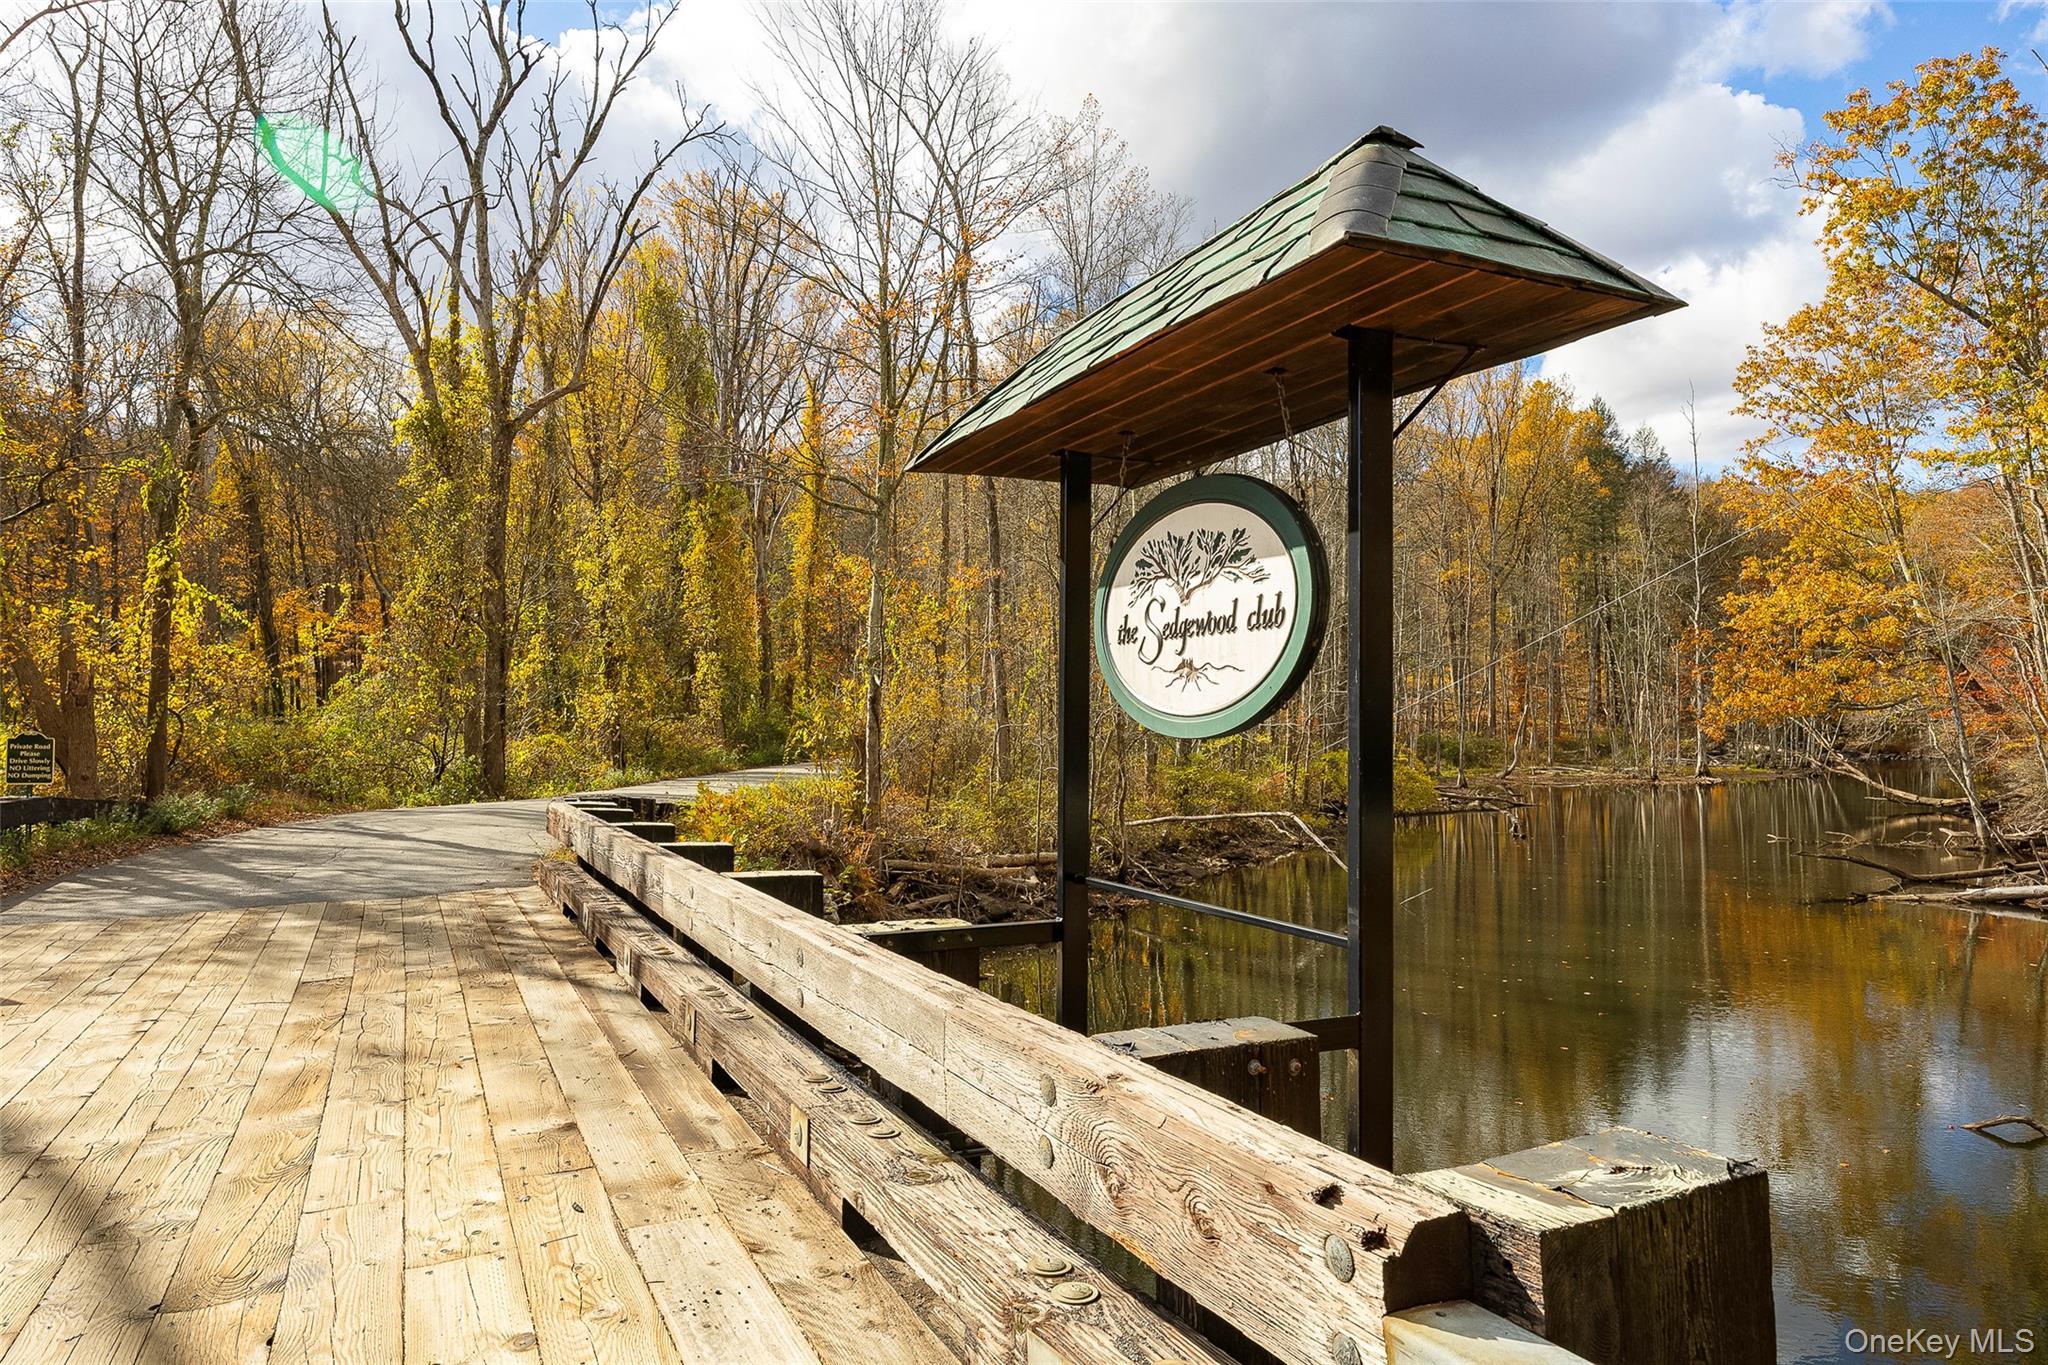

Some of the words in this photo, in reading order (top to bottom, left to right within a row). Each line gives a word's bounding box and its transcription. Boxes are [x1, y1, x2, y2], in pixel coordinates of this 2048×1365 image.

[1117, 614, 1139, 646] the
[1138, 596, 1239, 665] Sedgewood
[1247, 591, 1287, 631] club
[29, 757, 51, 765] Slowly
[21, 772, 52, 780] Dumping
